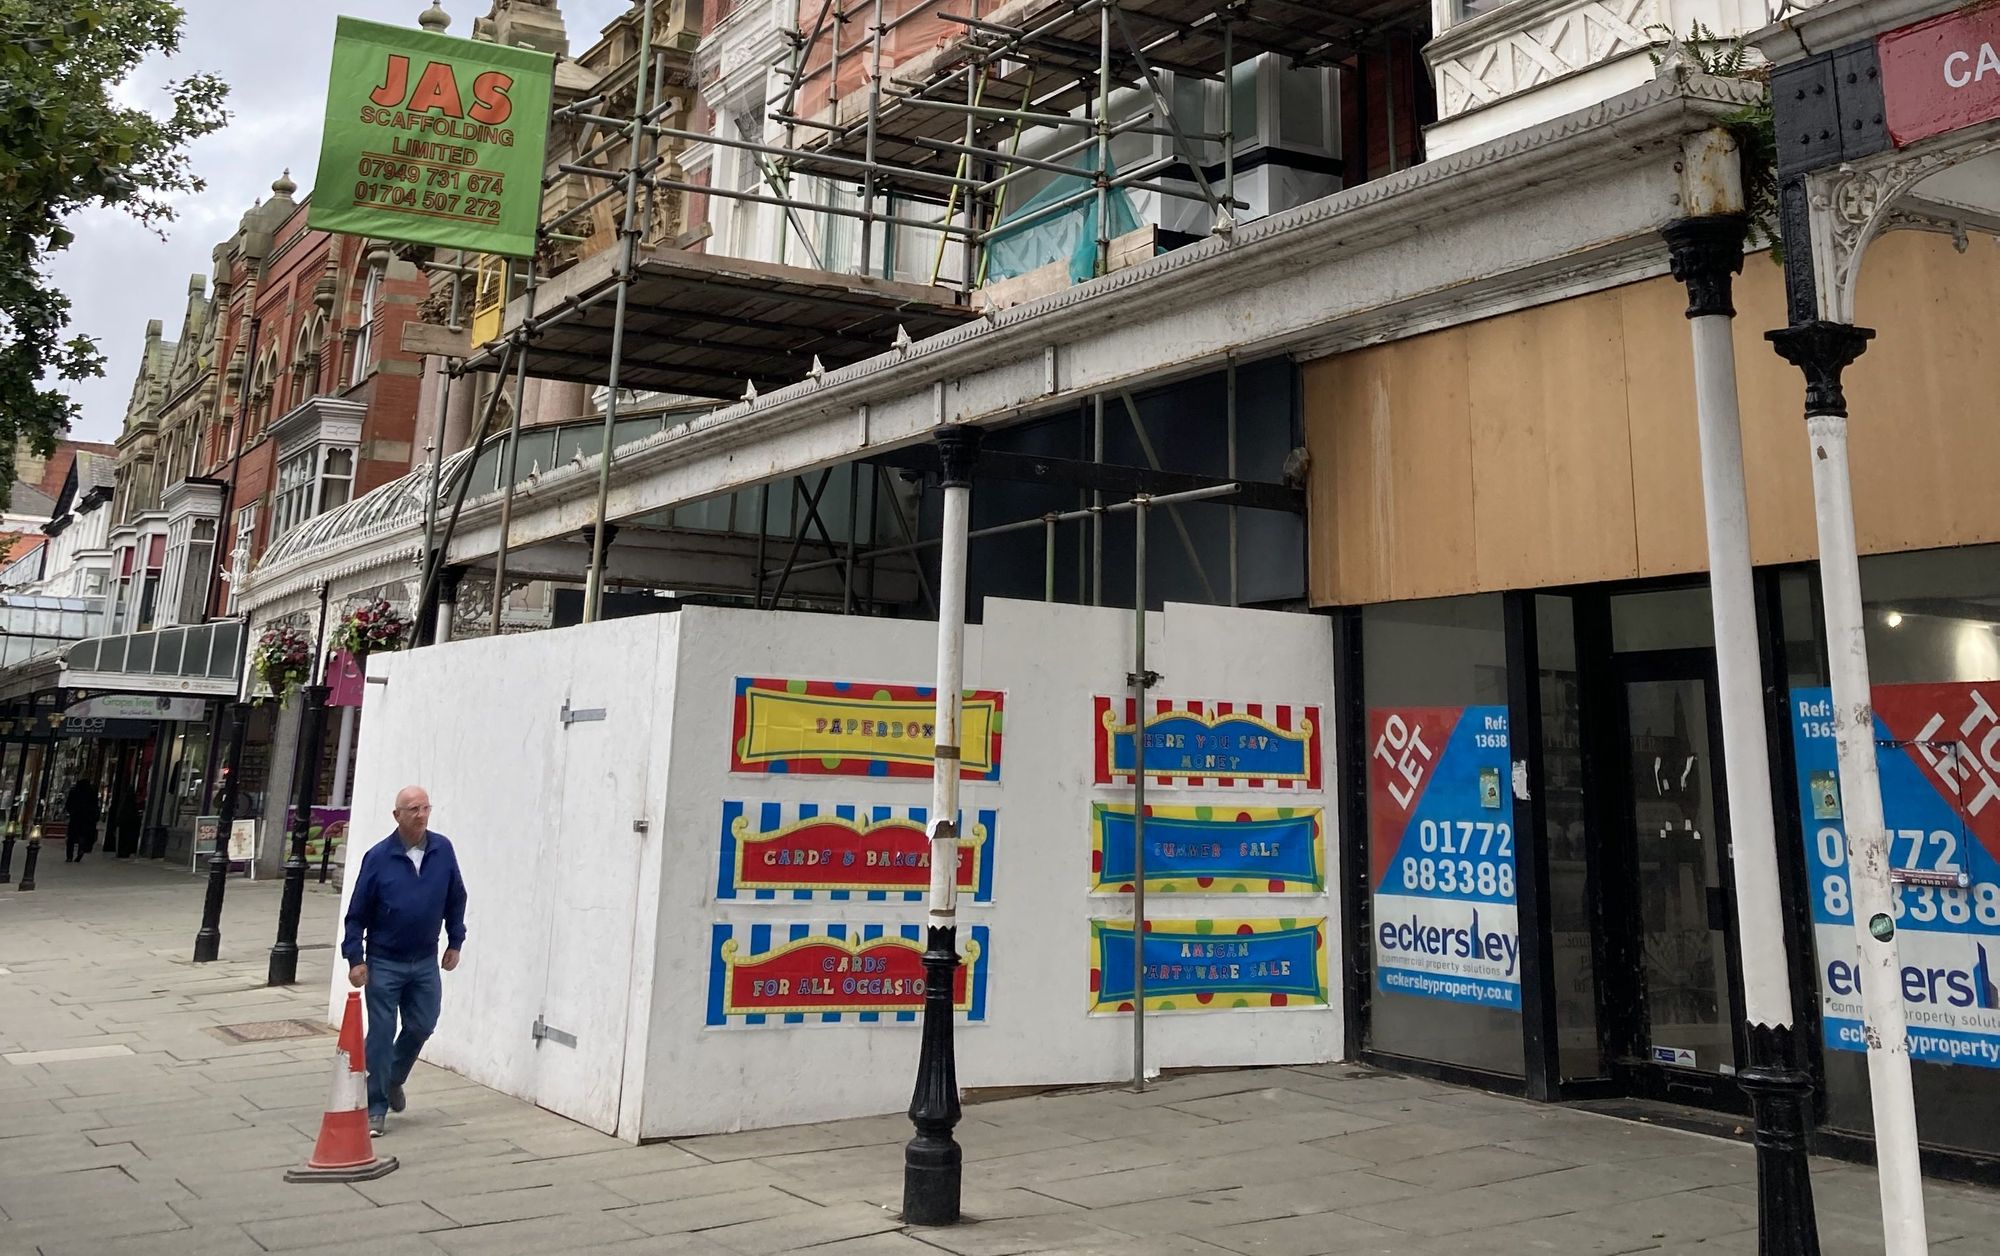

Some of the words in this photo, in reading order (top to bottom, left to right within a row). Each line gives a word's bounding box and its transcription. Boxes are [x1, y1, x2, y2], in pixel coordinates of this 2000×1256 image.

[368, 54, 514, 125] JAS
[360, 106, 514, 146] SCAFFOLDING
[392, 137, 479, 166] LIMITED
[358, 158, 421, 183] 07949
[426, 168, 460, 189] 731
[467, 176, 503, 196] 674
[355, 181, 416, 206] 01704
[422, 192, 461, 212] 507
[464, 199, 501, 218] 272
[1800, 701, 1830, 717] Ref:
[816, 718, 936, 738] PAPERBOX
[1484, 716, 1508, 731] Ref:
[1802, 722, 1837, 738] 1363
[1132, 732, 1185, 748] HERE
[1195, 734, 1230, 749] YOU
[1238, 736, 1279, 752] SAVE
[1373, 714, 1408, 769] TO
[1475, 734, 1508, 748] 13638
[1181, 754, 1241, 770] MONEY
[1388, 724, 1432, 810] LET
[1420, 820, 1512, 857] 01772
[764, 850, 832, 866] CARDS
[842, 852, 855, 866] &
[866, 851, 963, 868] BARGAS
[1154, 842, 1221, 858] SUMMER
[1240, 842, 1280, 857] SALE
[1817, 827, 1960, 872] 072
[1402, 856, 1514, 898] 883388
[1180, 942, 1250, 958] AMSCAN
[1380, 908, 1519, 976] eckersley
[822, 956, 887, 973] CARDS
[1250, 960, 1290, 978] SALE
[1426, 959, 1460, 974] property
[1462, 964, 1500, 976] solutions
[753, 978, 790, 997] FOR
[798, 978, 834, 995] ALL
[842, 977, 927, 995] OCCASIO
